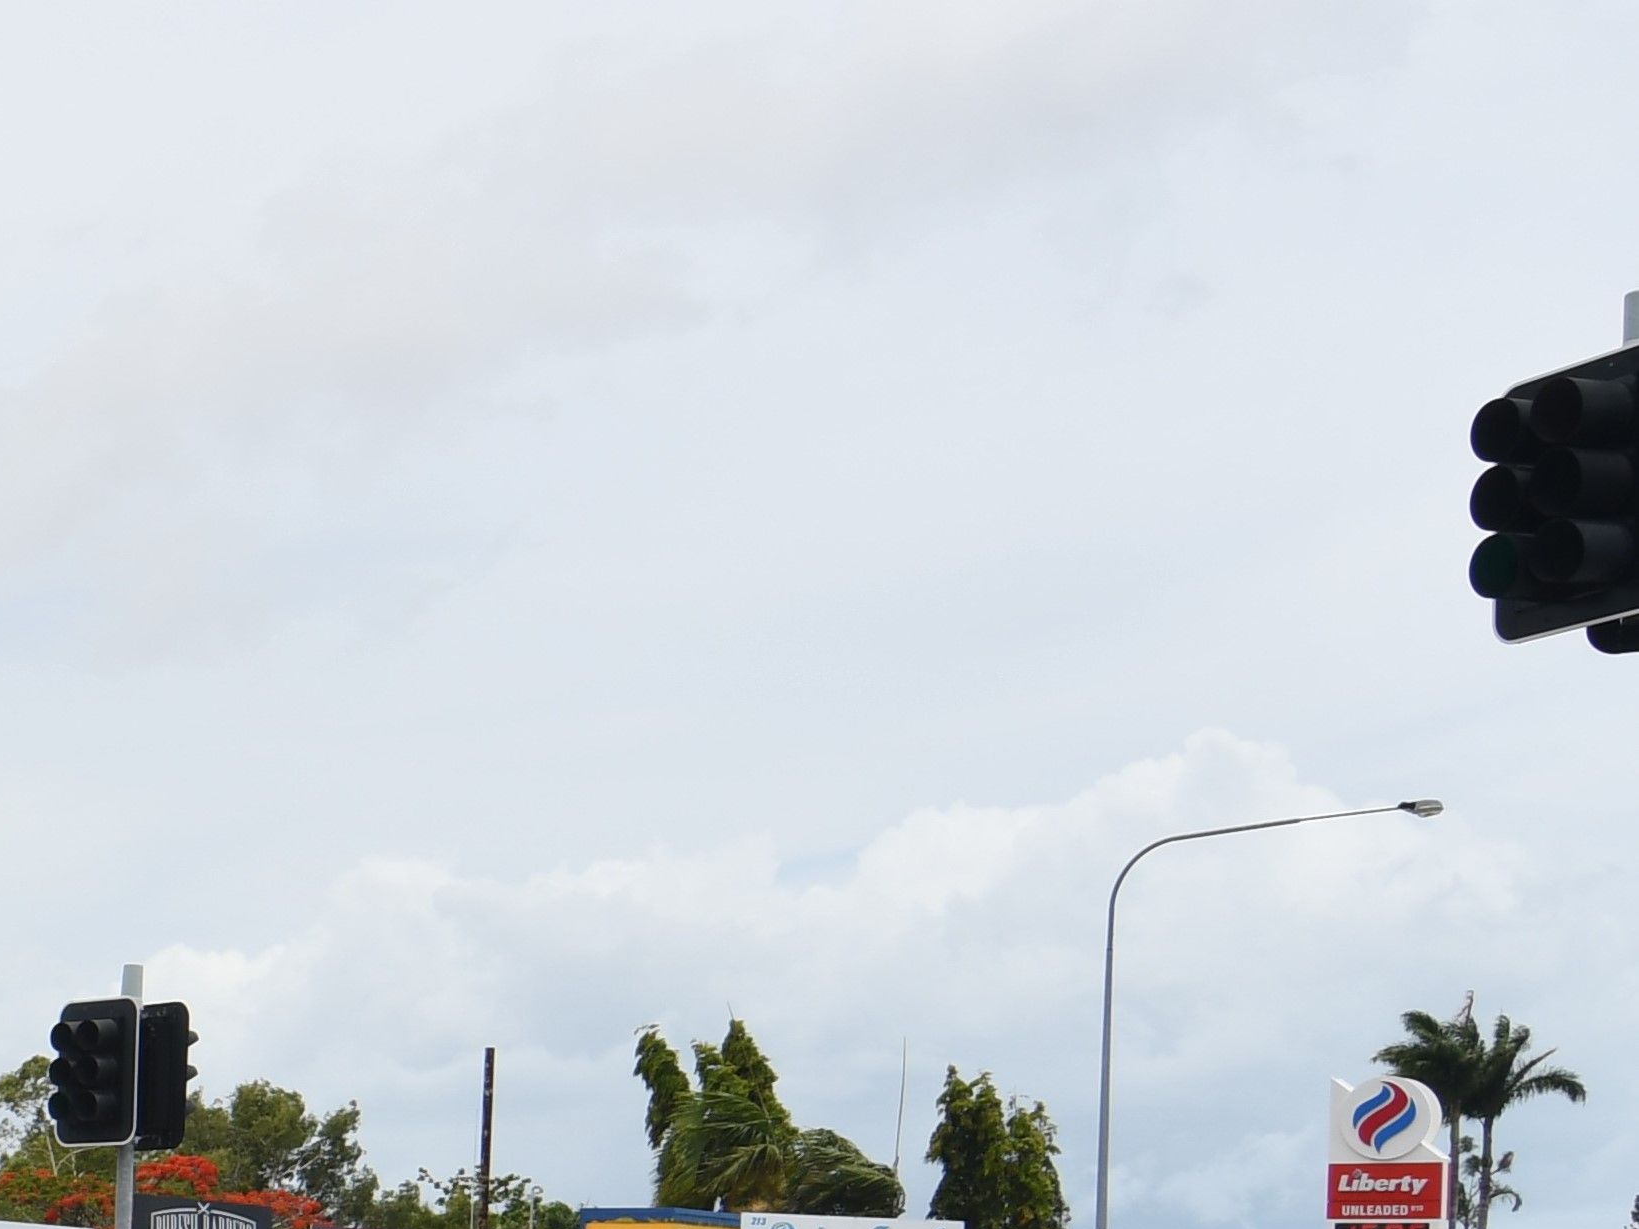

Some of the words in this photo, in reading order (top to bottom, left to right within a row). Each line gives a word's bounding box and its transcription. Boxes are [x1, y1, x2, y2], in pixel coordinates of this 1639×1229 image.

[1337, 1172, 1429, 1196] Liberty
[1341, 1205, 1408, 1216] UNLEADED
[751, 1217, 767, 1226] 213
